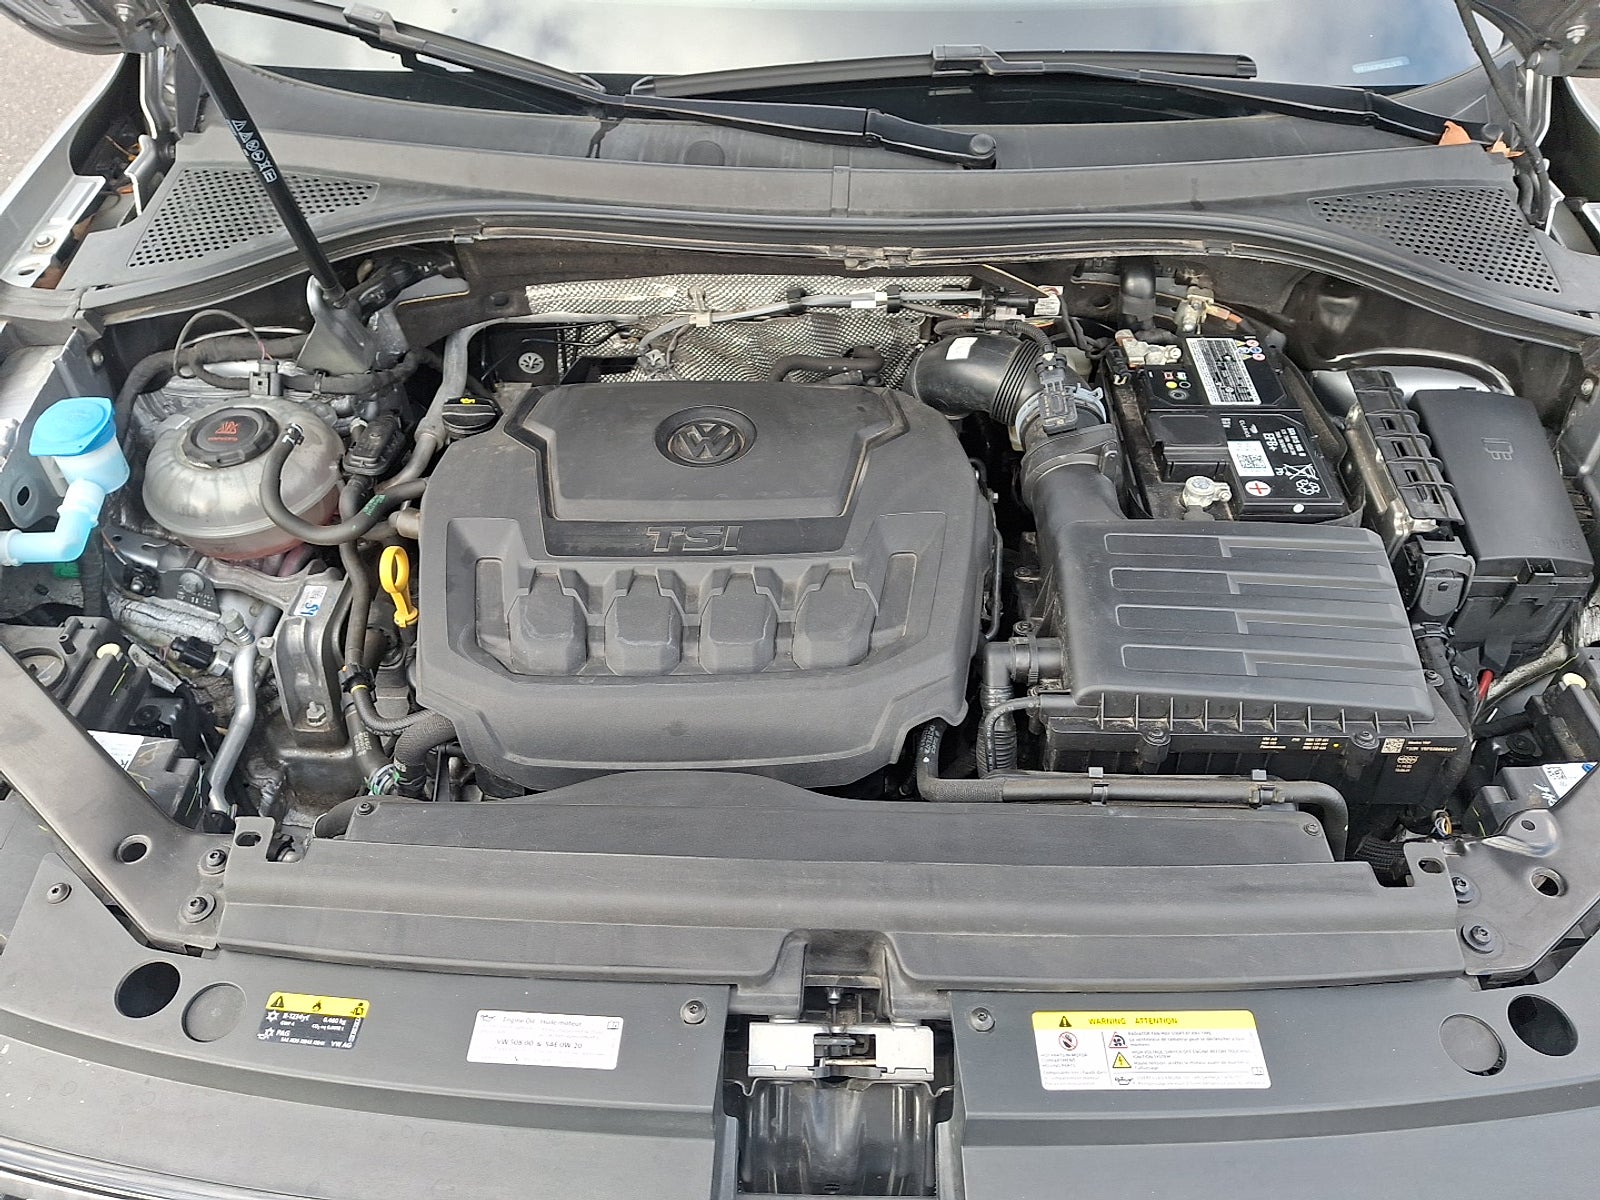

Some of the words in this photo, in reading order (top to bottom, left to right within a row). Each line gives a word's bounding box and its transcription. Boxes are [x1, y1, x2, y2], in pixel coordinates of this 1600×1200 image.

[1262, 432, 1280, 451] EFB+
[646, 526, 743, 553] TSI
[503, 1016, 524, 1024] Engine
[1088, 1017, 1127, 1025] WARNING
[1135, 1017, 1178, 1025] ATTENTION
[330, 1040, 342, 1048] VW
